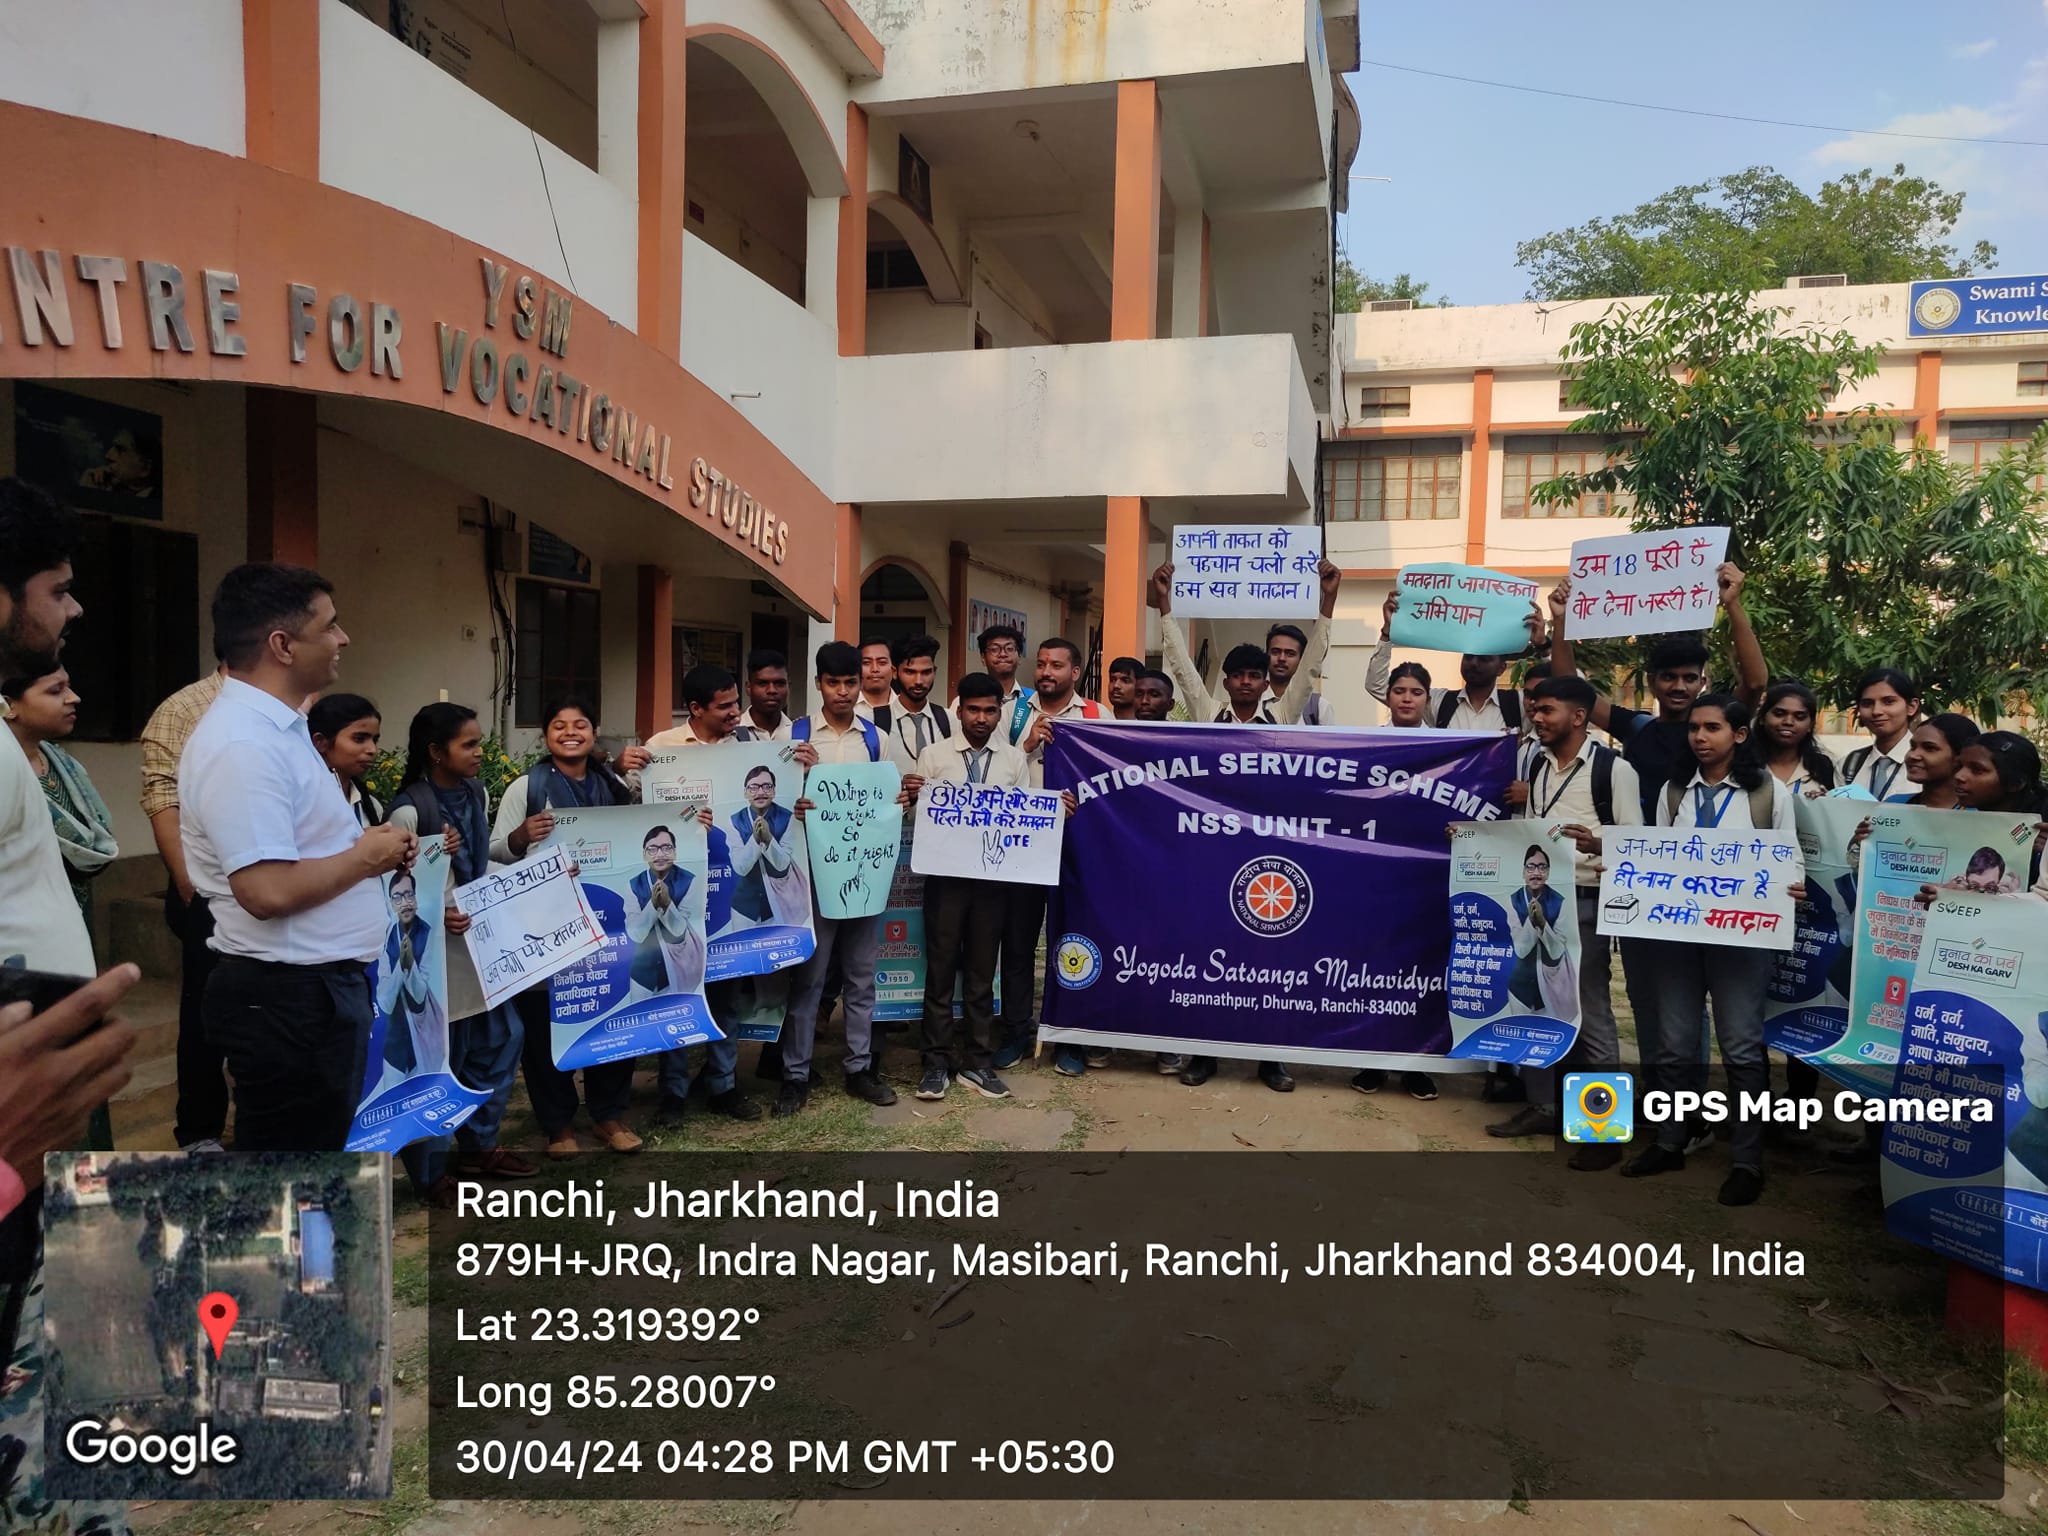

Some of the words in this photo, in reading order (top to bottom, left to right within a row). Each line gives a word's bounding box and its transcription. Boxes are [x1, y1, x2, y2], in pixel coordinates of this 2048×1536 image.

[1969, 282, 2035, 301] Swami
[480, 256, 573, 358] YSM
[0, 246, 247, 356] NTRE
[287, 282, 402, 380] FOR
[435, 321, 673, 491] VOCATIONAL
[688, 457, 789, 565] STUDIES
[1222, 532, 1263, 550] ताकत
[1268, 527, 1292, 549] को
[1187, 555, 1243, 573] पहचान
[1247, 551, 1287, 574] चलो
[1613, 554, 1637, 576] 18
[1645, 540, 1684, 572] पूरी
[1689, 537, 1713, 567] है
[1174, 581, 1206, 599] हम
[1247, 582, 1301, 599] मतदान
[1403, 573, 1455, 590] मतदाता
[1458, 577, 1540, 599] जागरूकता
[1573, 591, 1600, 620] वोट
[1603, 589, 1637, 616] देना
[817, 778, 867, 806] Voting
[873, 786, 883, 800] is
[1077, 755, 1209, 805] ATIONAL
[1218, 752, 1359, 783] SERVICE
[1367, 765, 1501, 821] SCHEME
[1030, 796, 1058, 814] काम
[1178, 812, 1242, 836] NSS
[1252, 814, 1332, 839] UNIT
[1362, 819, 1377, 840] 1
[1871, 816, 1900, 827] SWEEP
[824, 845, 839, 863] do
[847, 846, 857, 861] it
[861, 843, 894, 869] right
[1681, 834, 1709, 862] की
[1749, 838, 1767, 861] पे
[1772, 844, 1795, 862] एक
[1880, 850, 1908, 865] चुनाव
[1613, 861, 1640, 889] ही
[1637, 871, 1678, 890] नाम
[1682, 875, 1746, 897] करना
[1752, 869, 1776, 900] है
[1890, 863, 1908, 872] DESH
[1909, 865, 1919, 873] KA
[1920, 866, 1941, 876] GARV
[1236, 900, 1259, 927] NATIONAL
[1260, 923, 1287, 931] SERVICE
[1286, 904, 1306, 927] SCHEME
[1647, 899, 1703, 926] हमको
[1704, 907, 1784, 935] मतदान
[1937, 901, 1981, 917] SWEEP
[1113, 945, 1197, 985] Yogoda
[1203, 949, 1309, 993] Satsanga
[1938, 947, 1971, 962] चुनाव
[1973, 953, 1993, 966] का
[1996, 954, 2018, 970] पर्व
[1947, 961, 1970, 971] DESH
[1970, 964, 1984, 974] KA
[1985, 967, 2013, 979] GARV
[888, 975, 909, 983] 1950
[1169, 989, 1258, 1011] Jagannathpur,
[1263, 995, 1318, 1014] Dhurwa,
[1321, 999, 1417, 1016] Ranchi-834004
[1914, 1004, 1937, 1024] धर्म,
[1941, 1009, 1965, 1029] वर्ग,
[1911, 1024, 1939, 1045] जाति,
[1943, 1031, 1993, 1056] समुदाय,
[1872, 1050, 1895, 1062] 1950
[1908, 1044, 1932, 1061] भाषा
[1934, 1050, 1968, 1069] अथवा
[1903, 1059, 1933, 1081] किसी
[1934, 1067, 1950, 1085] भी
[1952, 1074, 2004, 1098] प्रलोभन
[2006, 1084, 2022, 1102] से
[1888, 1139, 1921, 1160] प्रयोग
[1892, 1122, 1951, 1148] मताधिकार
[1952, 1137, 1972, 1155] का
